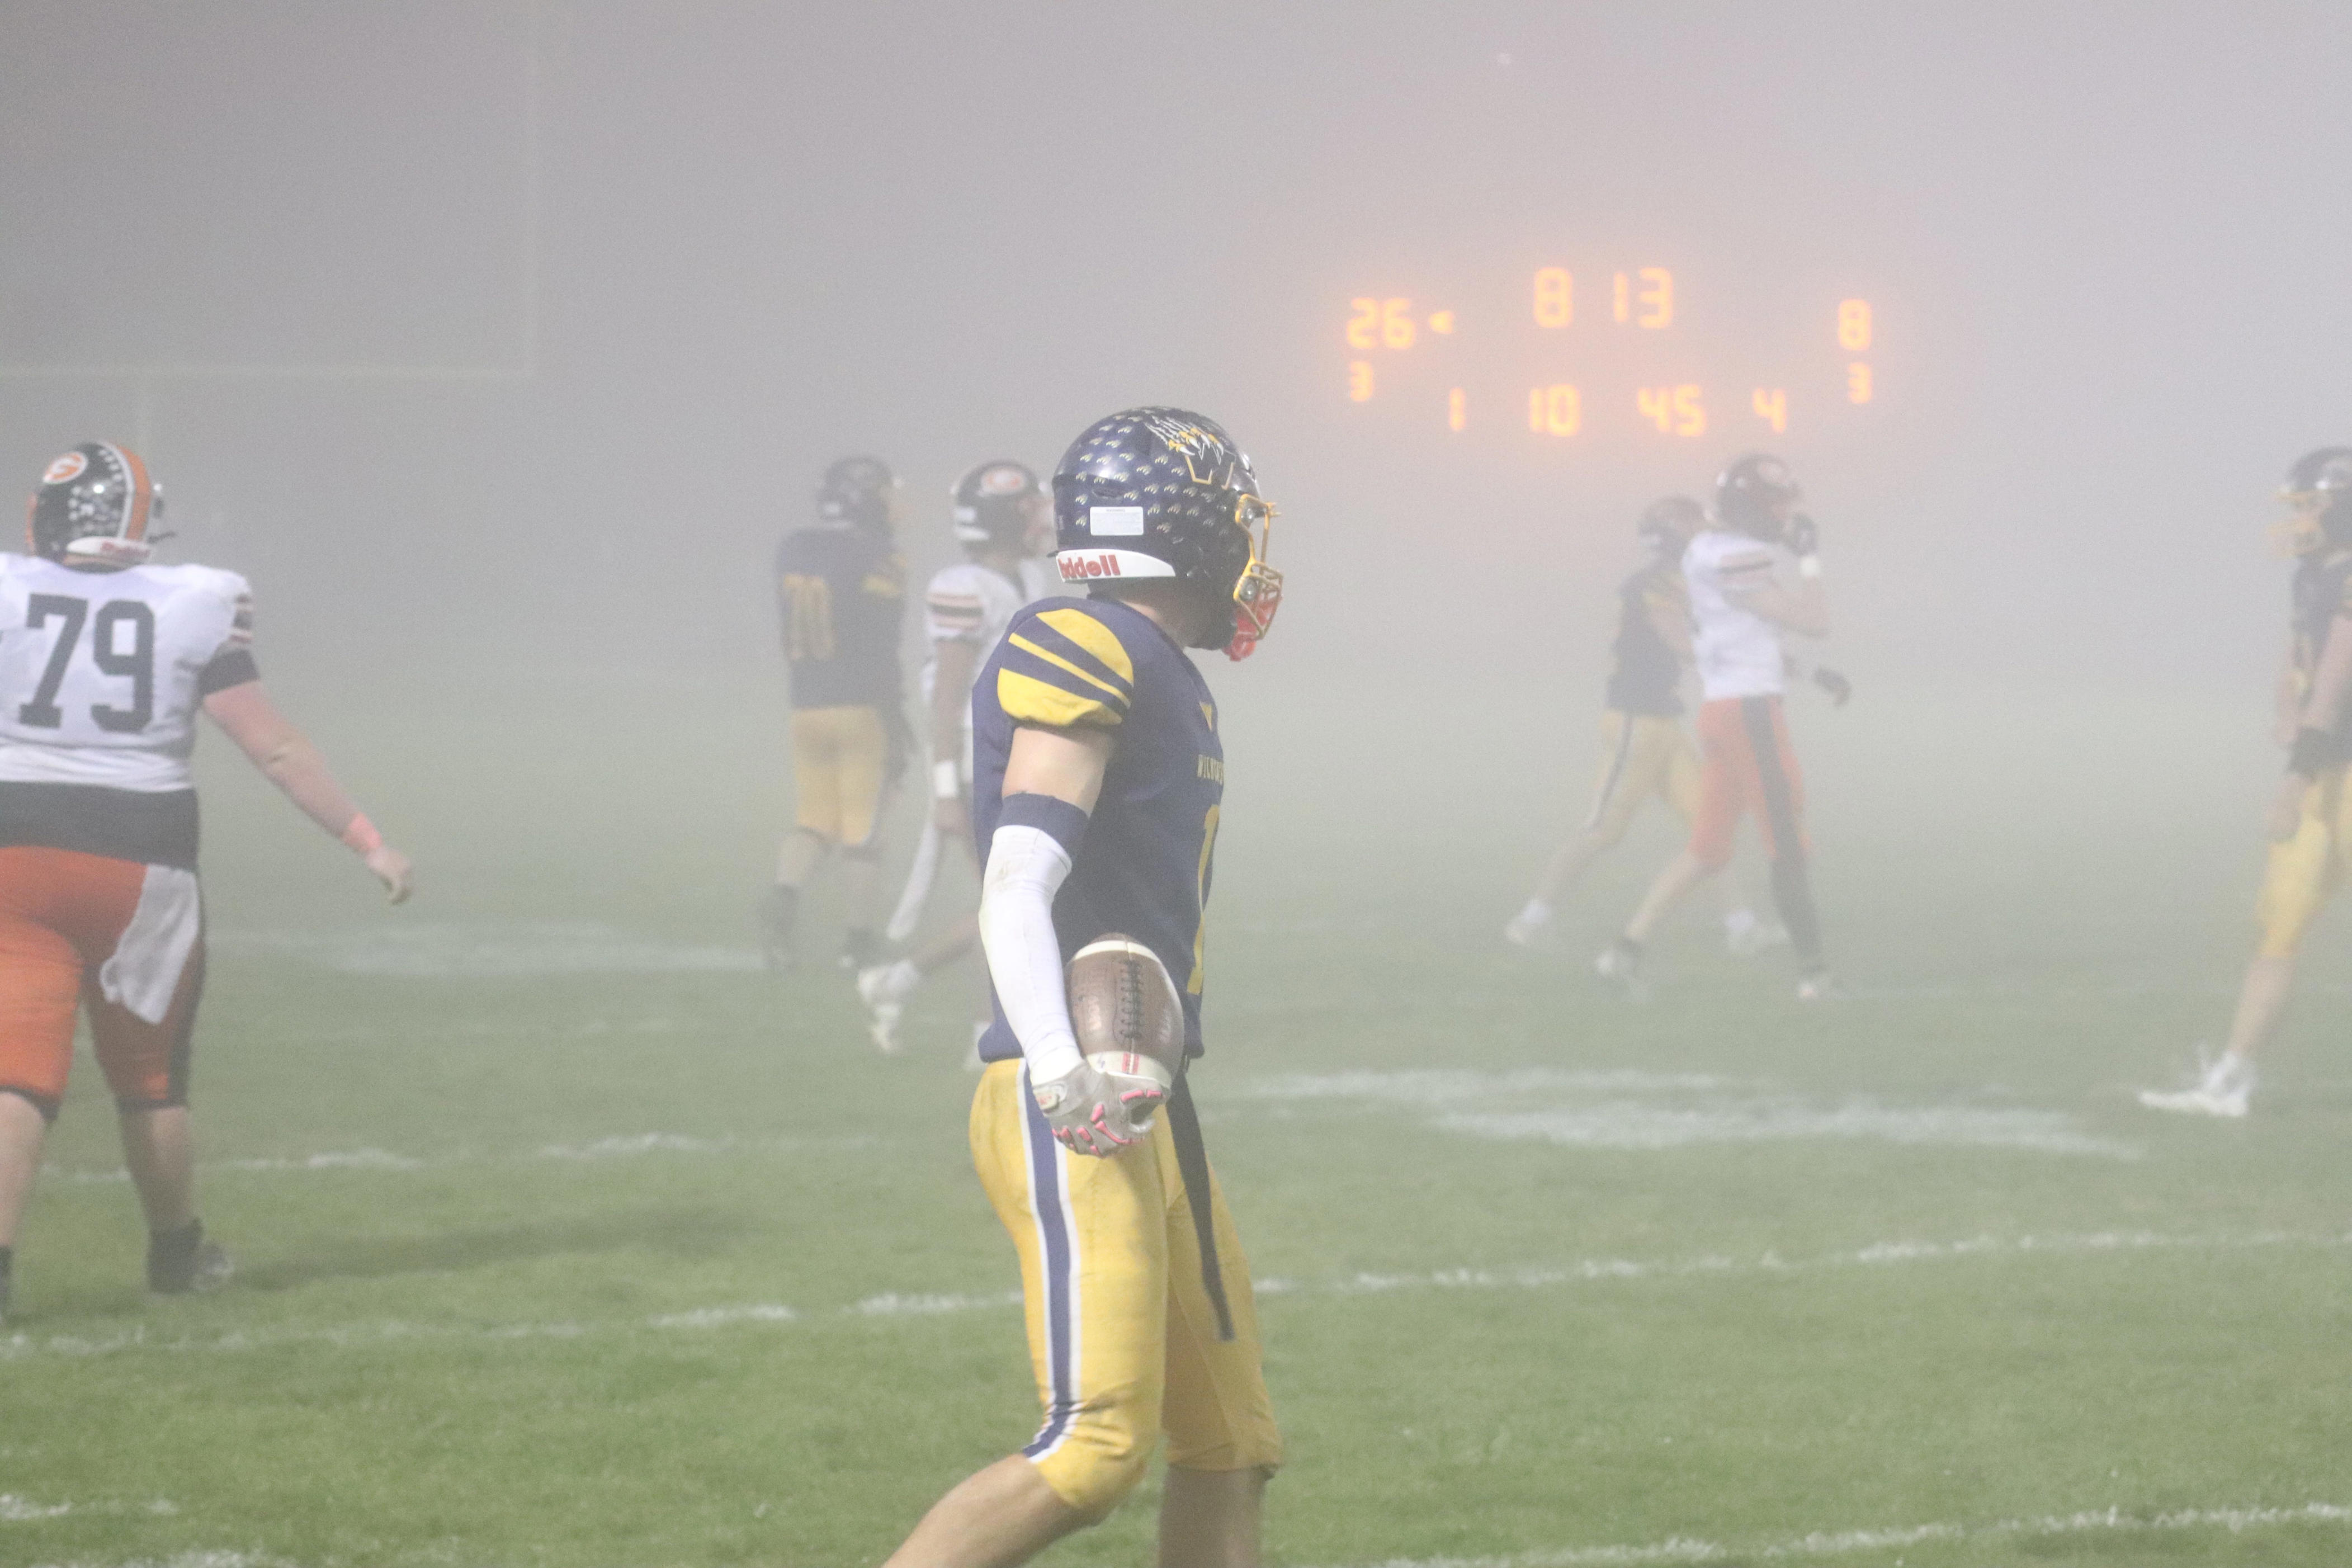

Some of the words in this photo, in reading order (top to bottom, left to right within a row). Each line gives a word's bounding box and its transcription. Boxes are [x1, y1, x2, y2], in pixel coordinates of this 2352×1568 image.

[1345, 297, 1417, 351] 26
[1533, 267, 1574, 329] 8
[1613, 267, 1673, 328] 13
[1838, 299, 1871, 351] 8
[1349, 360, 1375, 402] 3
[1849, 362, 1872, 403] 3
[1449, 387, 1466, 431] 1
[1529, 383, 1581, 437] 10
[1637, 384, 1707, 437] 45
[1753, 389, 1787, 432] 4
[18, 593, 155, 735] 79
